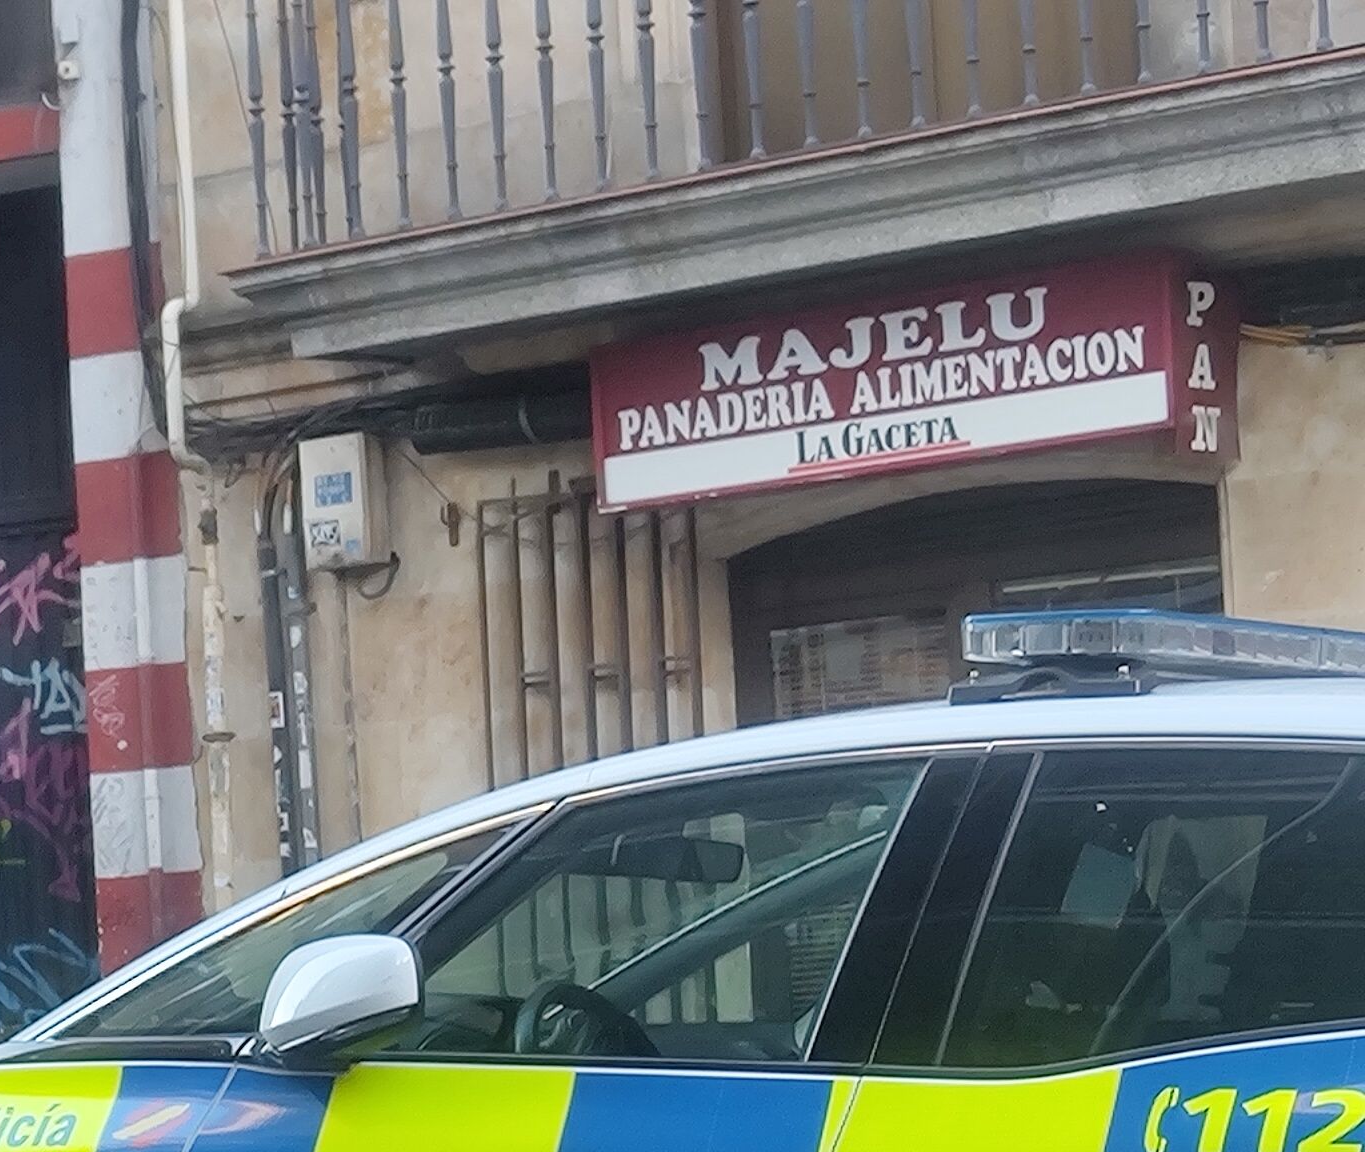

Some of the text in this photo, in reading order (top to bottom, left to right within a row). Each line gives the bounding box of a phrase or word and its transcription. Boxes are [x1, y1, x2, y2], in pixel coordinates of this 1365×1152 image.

[617, 325, 1146, 451] PANADERIA ALIMENTACION
[699, 286, 1049, 392] MAJELU
[1185, 280, 1222, 454] PAN
